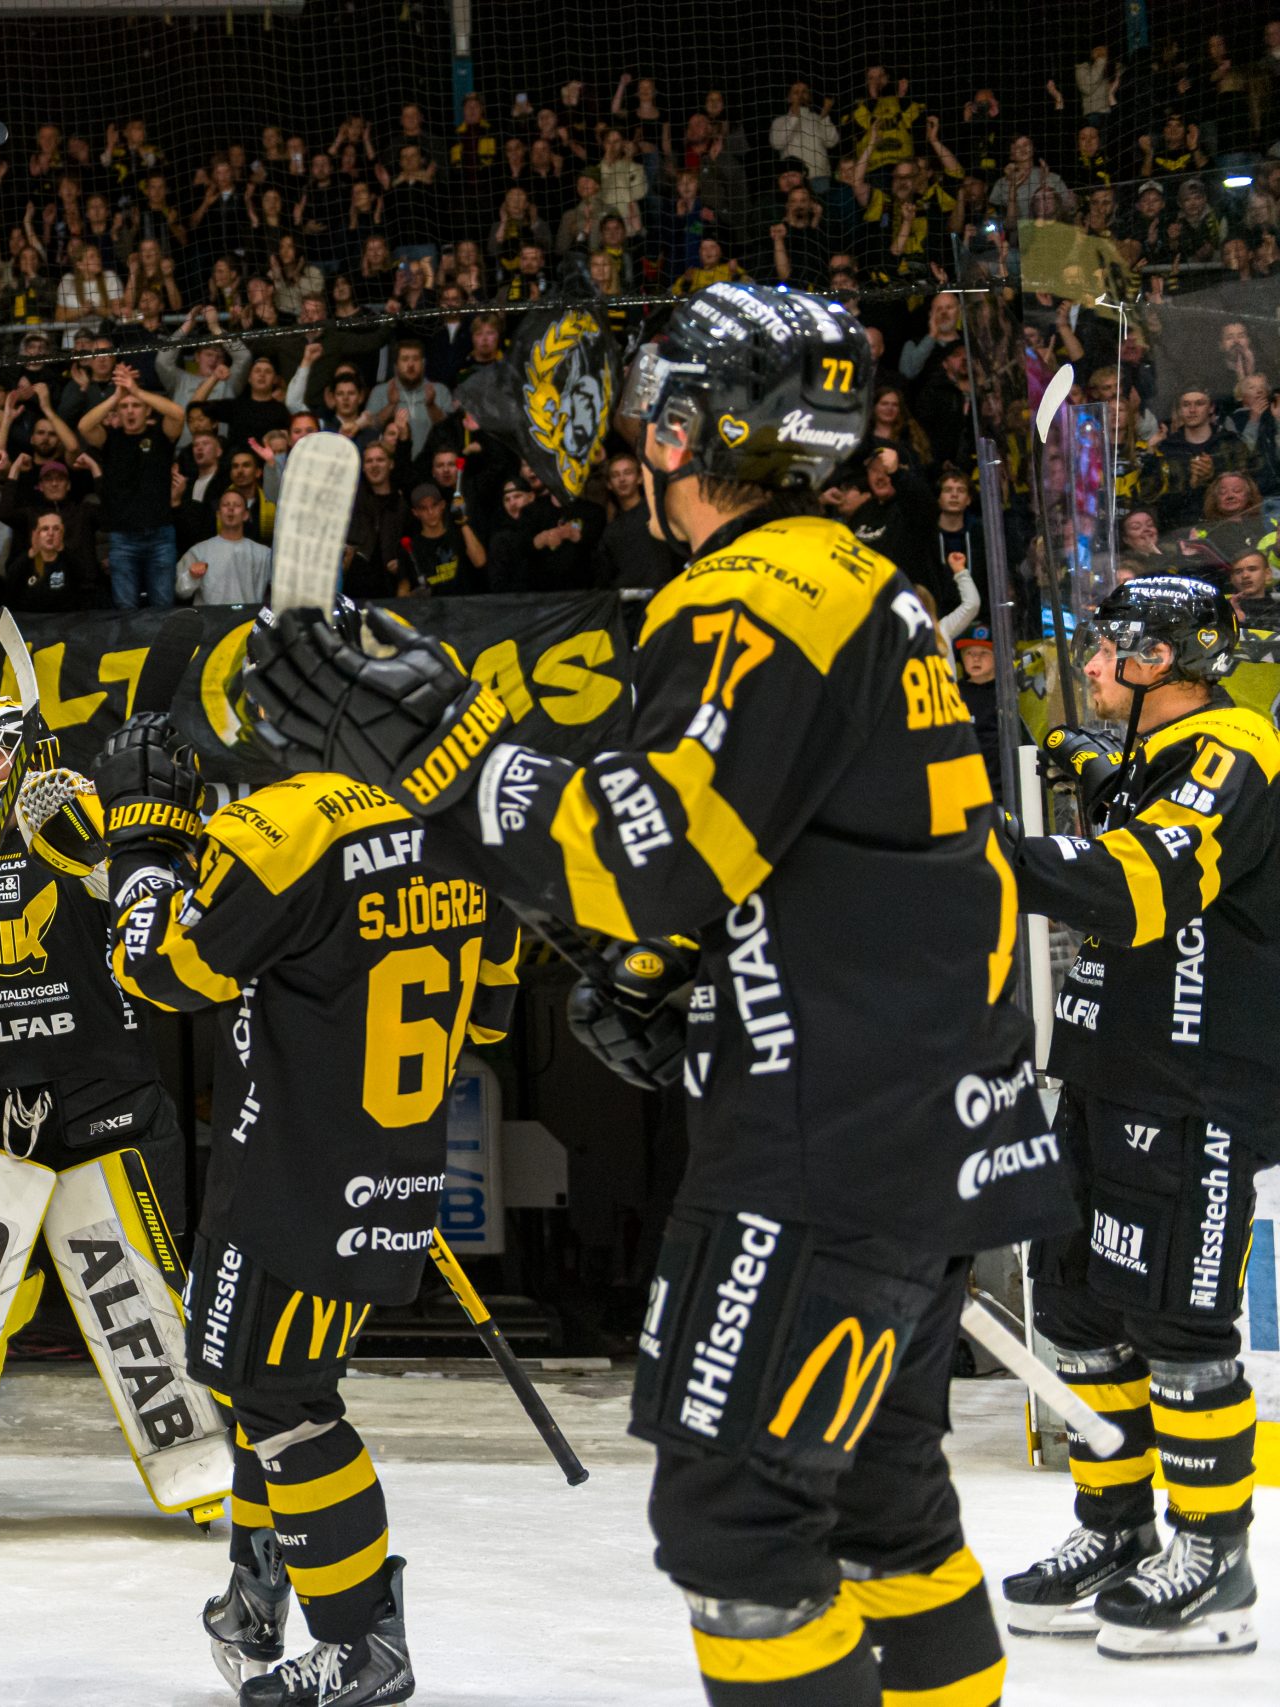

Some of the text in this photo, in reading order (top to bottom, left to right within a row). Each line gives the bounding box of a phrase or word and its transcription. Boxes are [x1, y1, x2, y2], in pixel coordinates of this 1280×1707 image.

[821, 357, 855, 393] 77
[764, 563, 820, 600] TEAM
[692, 608, 776, 711] 77
[61, 803, 90, 842] WARRIOR
[250, 814, 283, 844] TEAM
[598, 767, 673, 869] APEL
[5, 877, 18, 891] &
[124, 896, 158, 962] APEL
[135, 1190, 175, 1273] WARRIOR
[1192, 1168, 1229, 1290] Hisstech
[1104, 1249, 1148, 1274] RENTAL
[205, 1243, 243, 1348] Hisste
[66, 1238, 195, 1448] ALFAB
[1181, 1586, 1218, 1619] BAUER
